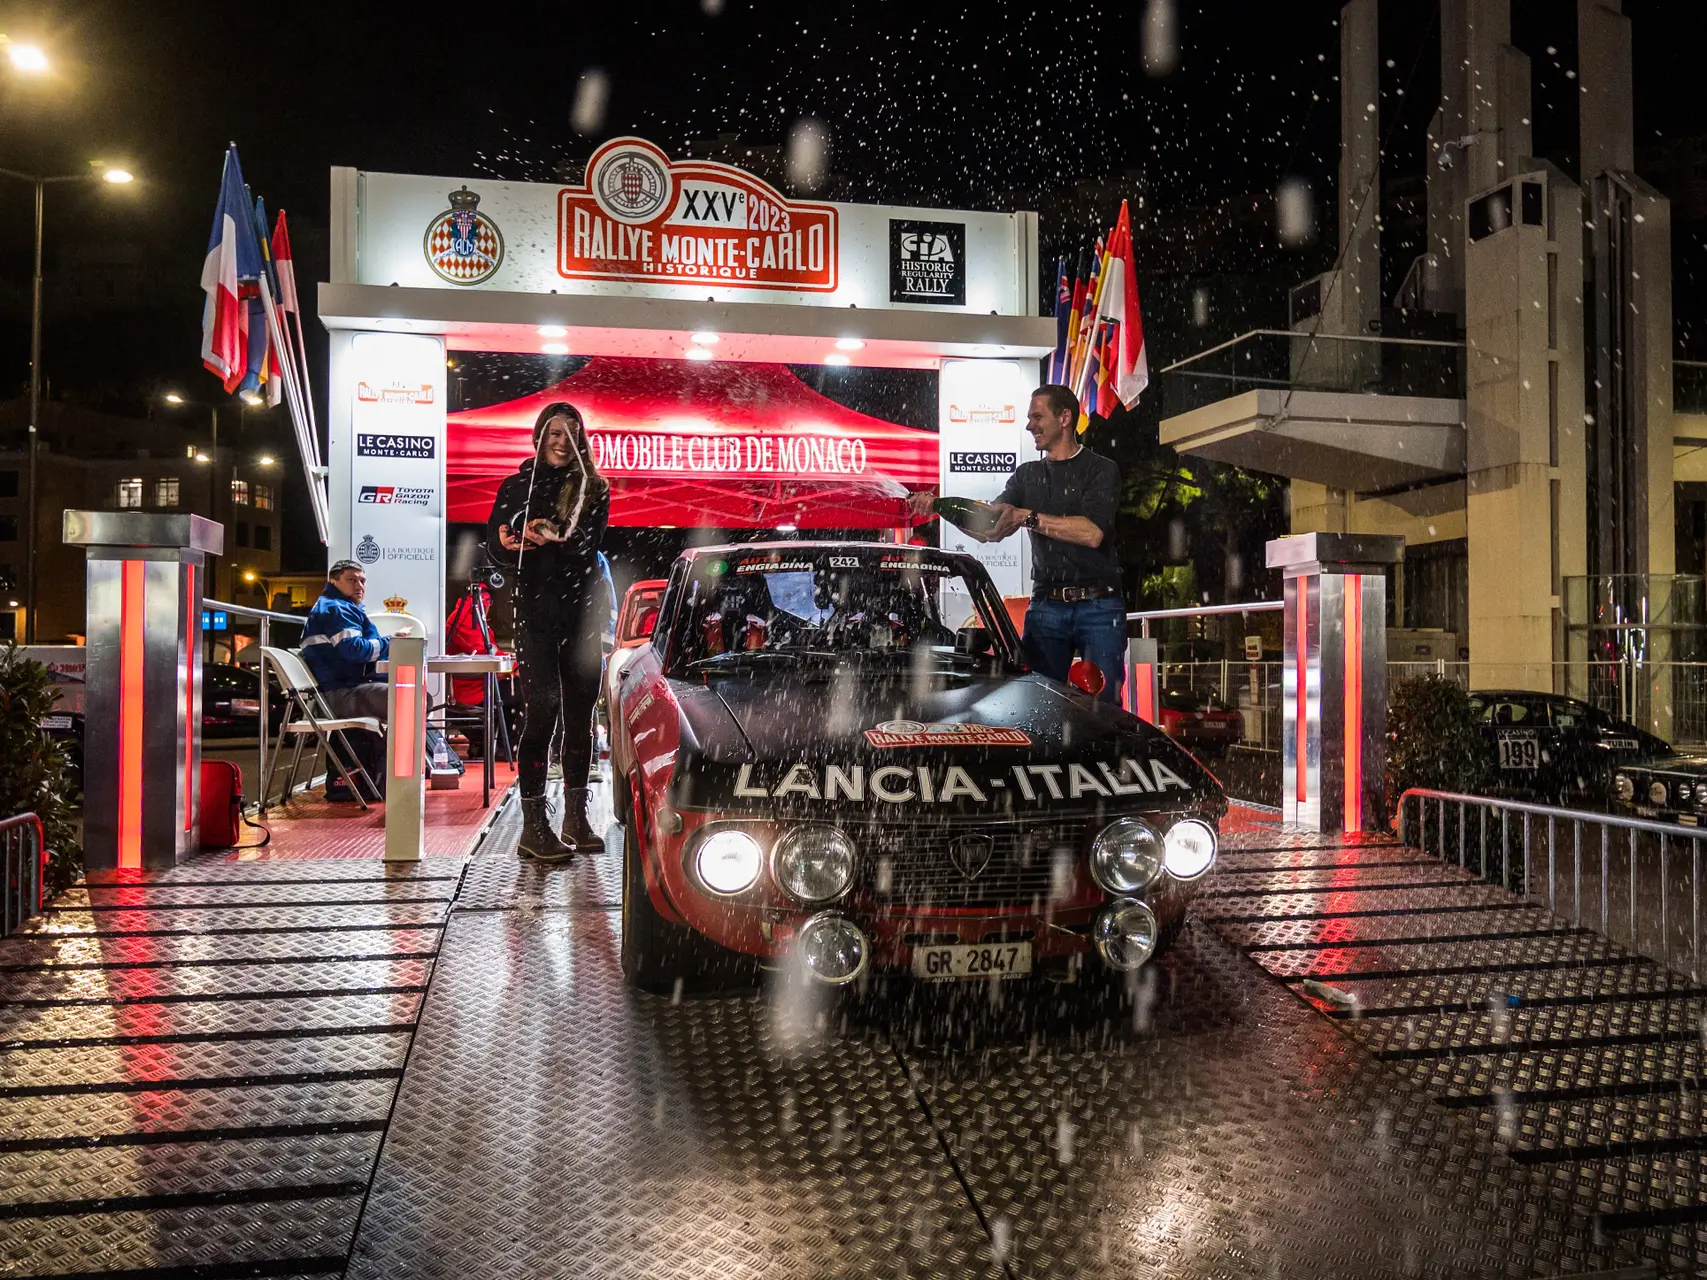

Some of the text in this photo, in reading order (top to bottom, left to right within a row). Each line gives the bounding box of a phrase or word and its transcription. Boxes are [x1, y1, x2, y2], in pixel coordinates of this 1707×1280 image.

[749, 194, 791, 233] 2023
[574, 206, 824, 272] RALLYE MONTE-CARLO
[643, 262, 757, 279] HISTORIQUE
[901, 260, 955, 272] HISTORIC
[901, 270, 954, 279] REGULARITY
[906, 277, 949, 293] RALLY
[359, 436, 433, 449] LE CASINO
[688, 436, 741, 472] CLUB
[746, 436, 775, 471] DE
[776, 436, 867, 474] MONACO
[951, 453, 1015, 464] LE CASINO
[358, 492, 392, 504] GR
[394, 498, 428, 506] Racing
[387, 553, 435, 561] OFFICIELLE
[398, 547, 435, 555] BOUTIQUE
[736, 562, 814, 573] ENGIADINA
[832, 557, 857, 567] 242
[880, 561, 951, 573] ENGIADINA
[872, 730, 1024, 745] RALLYE MONTE-CARLO
[1608, 740, 1634, 749] TURIN
[1502, 740, 1536, 767] 199
[926, 950, 953, 975] GR
[966, 947, 1019, 973] 2847
